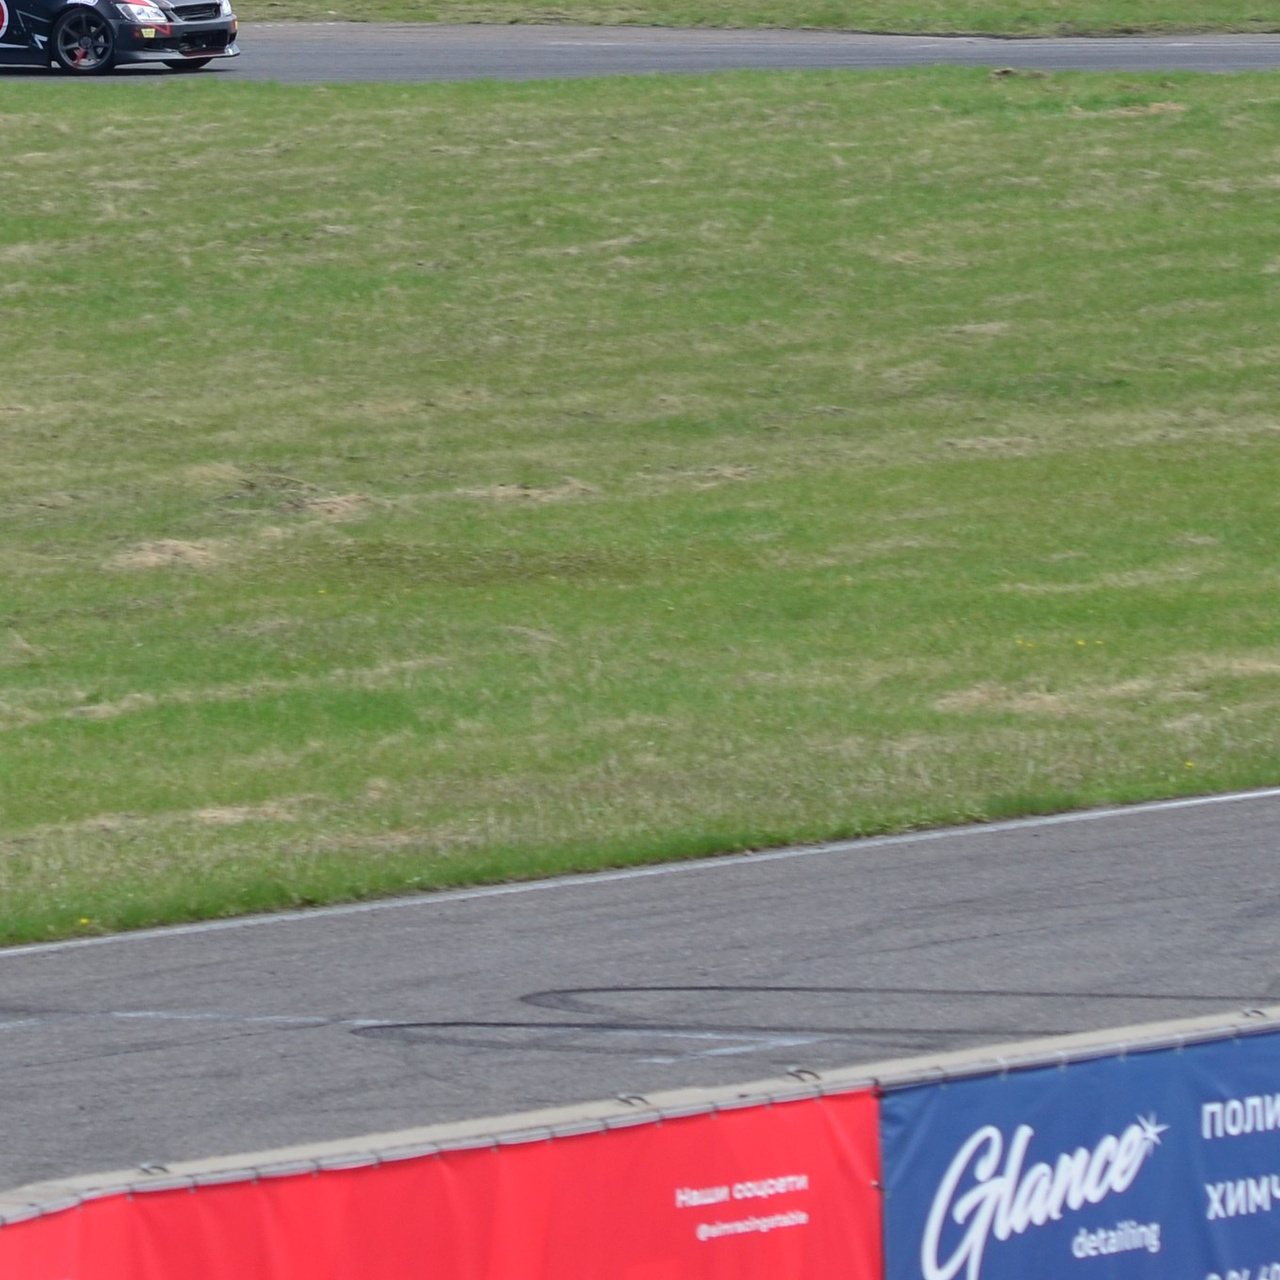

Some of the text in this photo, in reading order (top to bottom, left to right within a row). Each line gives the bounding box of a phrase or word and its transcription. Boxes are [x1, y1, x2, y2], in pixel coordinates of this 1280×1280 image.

[675, 1174, 808, 1208] Наши соцсети
[921, 1124, 1150, 1280] Glance
[1072, 1220, 1161, 1259] detailing
